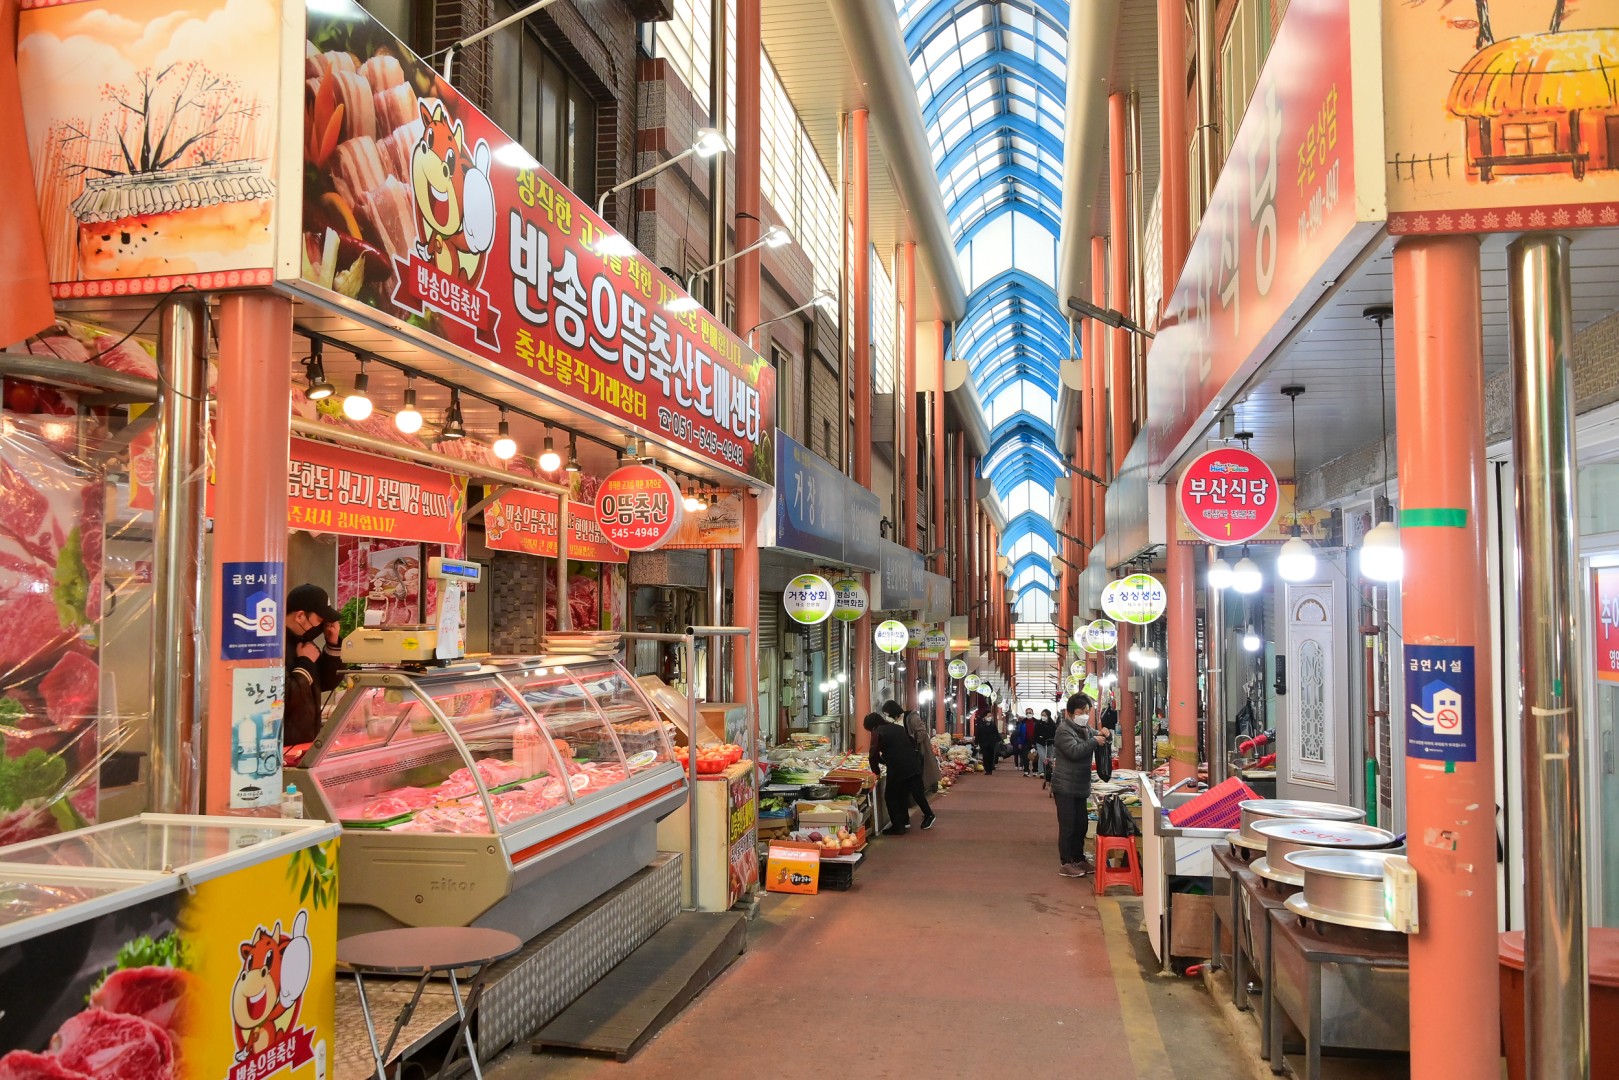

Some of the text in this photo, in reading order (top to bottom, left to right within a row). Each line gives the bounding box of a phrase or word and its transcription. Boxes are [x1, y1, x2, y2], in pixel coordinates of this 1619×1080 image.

[1297, 82, 1338, 198] 주문상담
[627, 254, 653, 299] 착한
[417, 264, 481, 323] 반송으뜸축산
[514, 327, 647, 421] 축산물직거래장터
[672, 414, 744, 467] 051-545-4948
[337, 468, 375, 509] 생고기
[376, 477, 421, 516] 전문매장
[421, 490, 449, 519] 입니다
[1188, 477, 1269, 506] 부산식당
[288, 505, 333, 528] 주셔서
[600, 492, 669, 525] 으뜸축산
[611, 527, 660, 539] 545-4948
[1224, 521, 1232, 537] 1
[232, 573, 279, 586] 금연시설
[788, 590, 828, 601] 거창상회
[835, 599, 864, 608] 찬백화점
[1119, 591, 1161, 602] 싱싱생선
[1409, 658, 1462, 673] 금연시설
